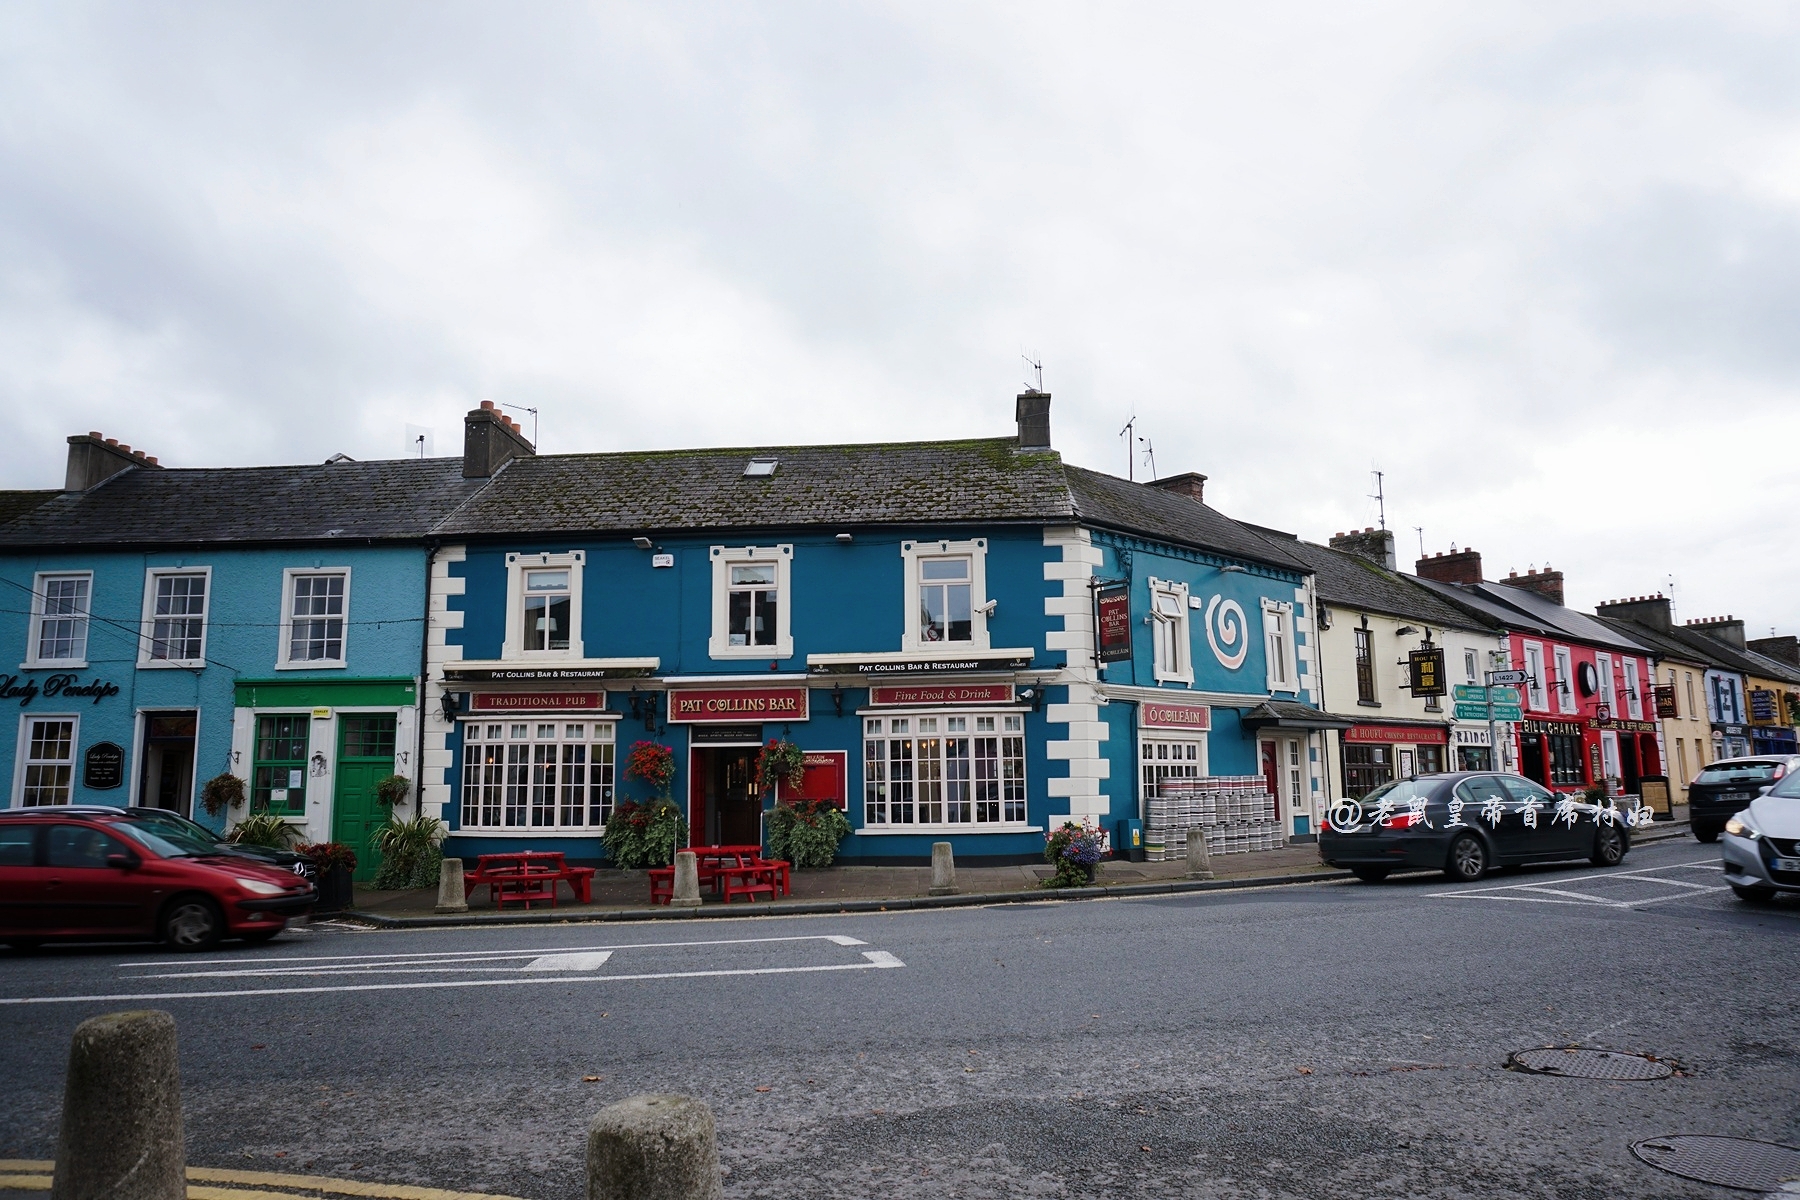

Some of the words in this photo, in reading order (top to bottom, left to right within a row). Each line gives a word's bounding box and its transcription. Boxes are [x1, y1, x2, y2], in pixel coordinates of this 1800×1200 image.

[1101, 613, 1127, 622] COLLINS
[0, 674, 39, 707] Lady
[43, 674, 119, 704] Penelope
[895, 691, 917, 700] Fine
[920, 690, 944, 699] Food
[948, 690, 956, 699] &
[960, 689, 991, 698] Drink
[565, 697, 586, 705] PUB
[680, 699, 703, 712] PAT
[707, 698, 765, 711] COLLINS
[769, 698, 796, 711] BAR
[1150, 707, 1157, 721] Ó
[1159, 709, 1200, 723] COILEÁIN
[1524, 720, 1545, 733] BILL
[1639, 723, 1654, 731] GARDEN
[1360, 729, 1382, 739] HOUFU
[1385, 731, 1405, 740] CHINESE
[1407, 732, 1436, 740] RESTAURANT
